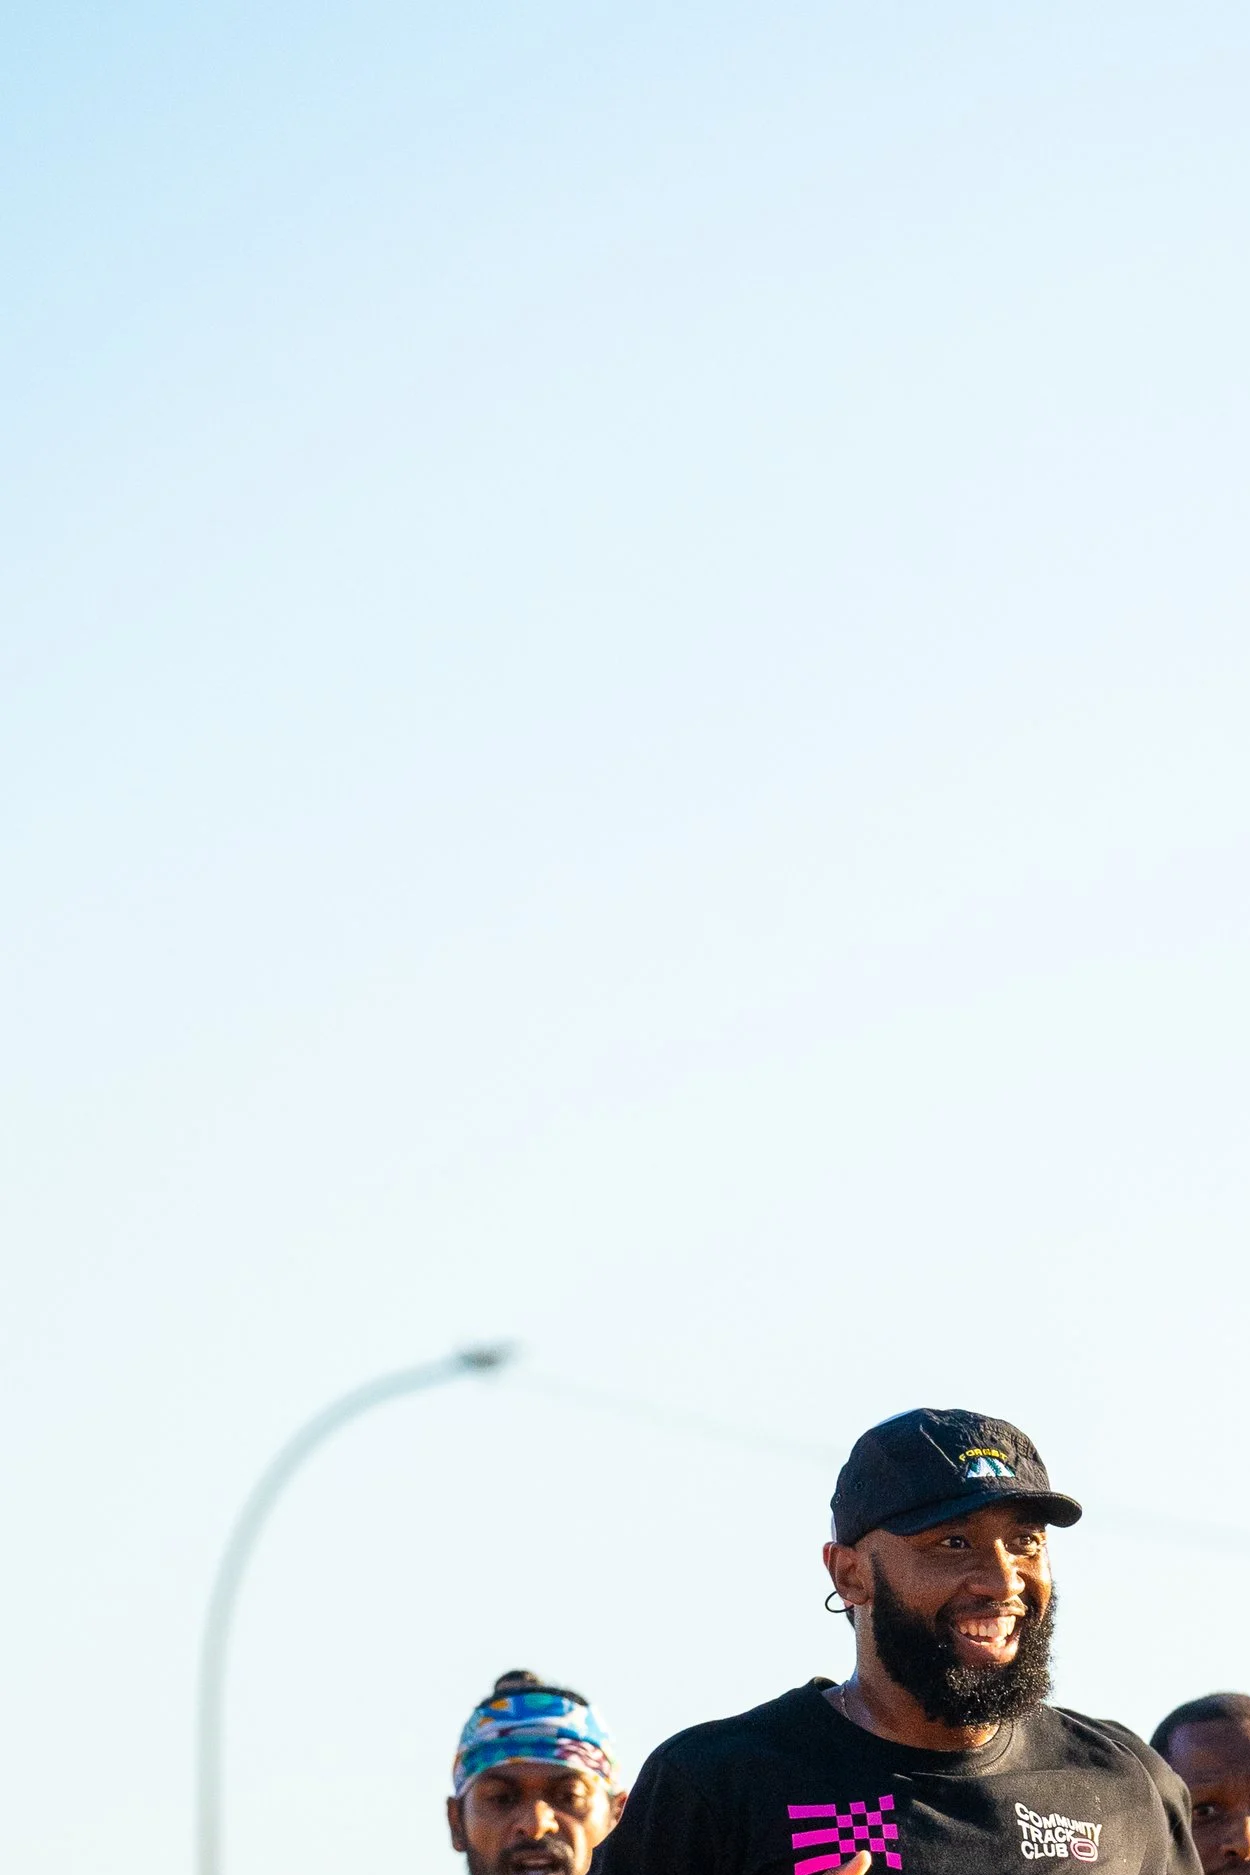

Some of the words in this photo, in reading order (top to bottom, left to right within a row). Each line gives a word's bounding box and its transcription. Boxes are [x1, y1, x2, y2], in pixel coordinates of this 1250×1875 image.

[1014, 1802, 1102, 1847] COMMUNITY
[1017, 1819, 1077, 1843] TRACK
[1020, 1840, 1069, 1860] CLUB
